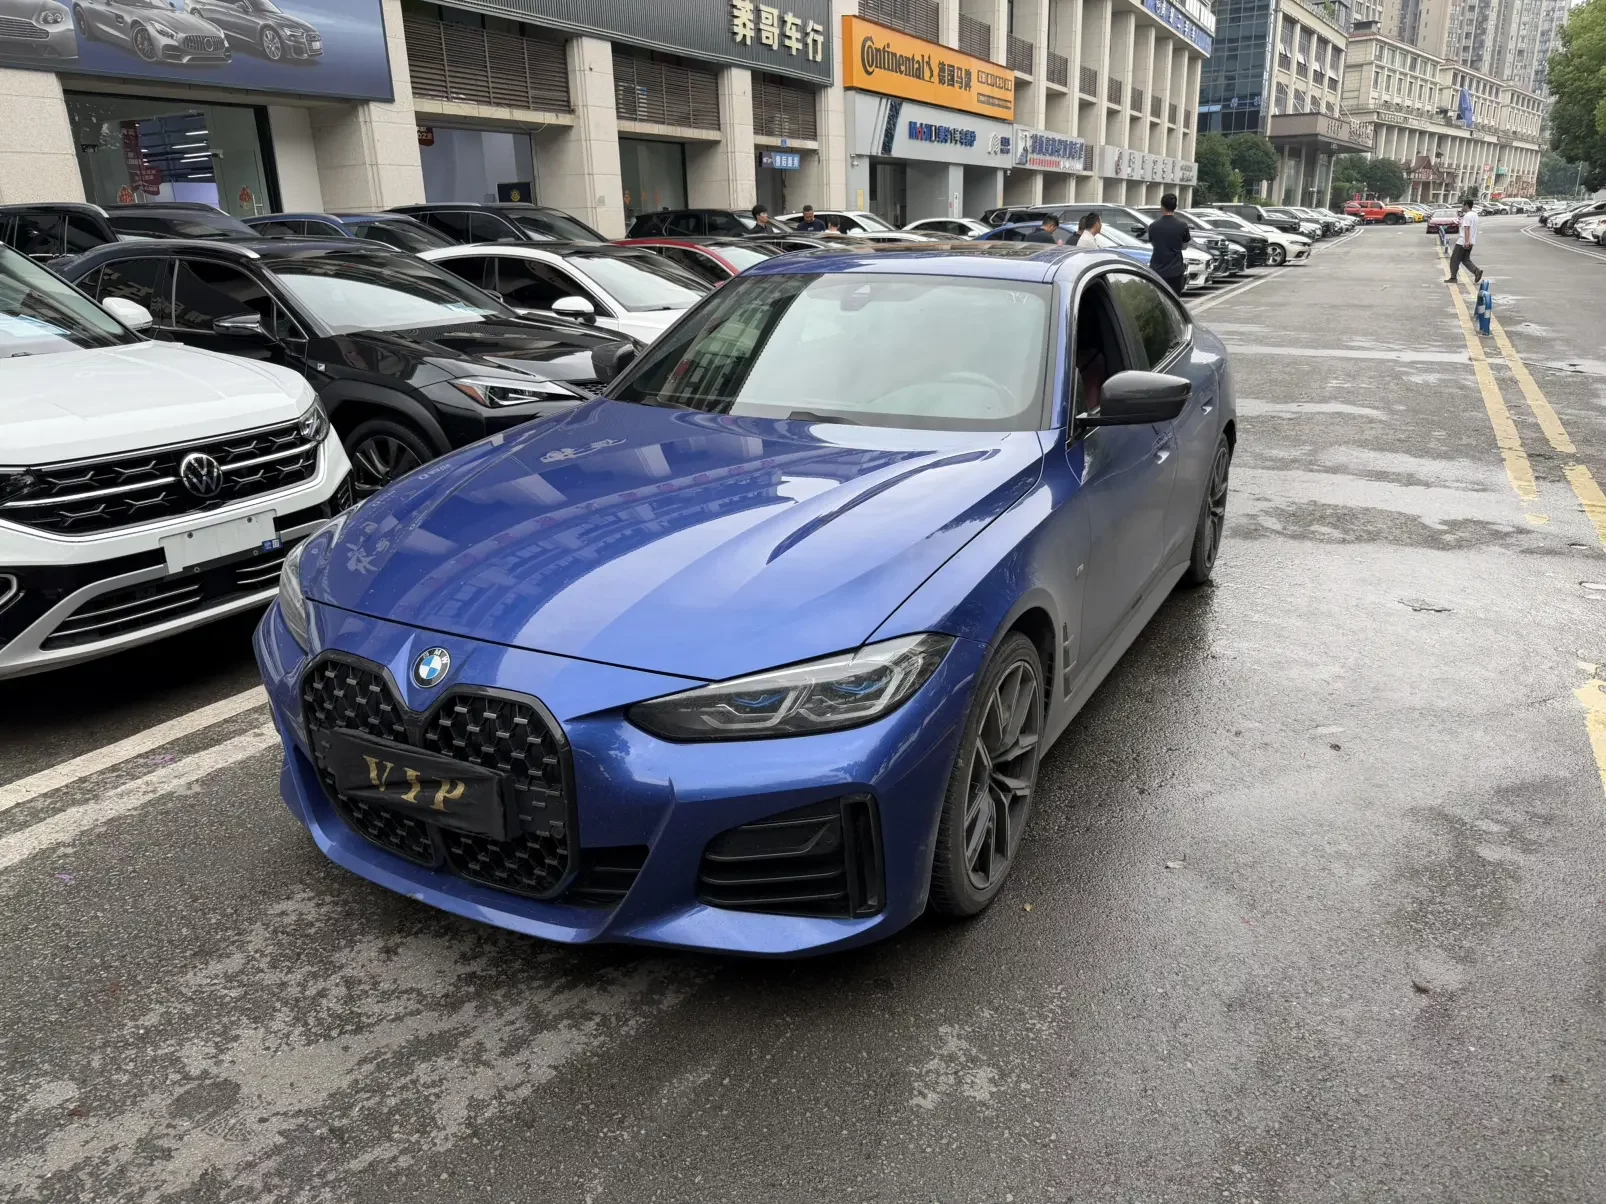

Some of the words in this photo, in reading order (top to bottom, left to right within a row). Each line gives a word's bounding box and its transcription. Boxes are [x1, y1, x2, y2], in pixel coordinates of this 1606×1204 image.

[861, 36, 925, 80] Continental
[938, 60, 972, 92] 德国马牌
[775, 155, 800, 168] 售后服务
[362, 754, 466, 813] VIP
